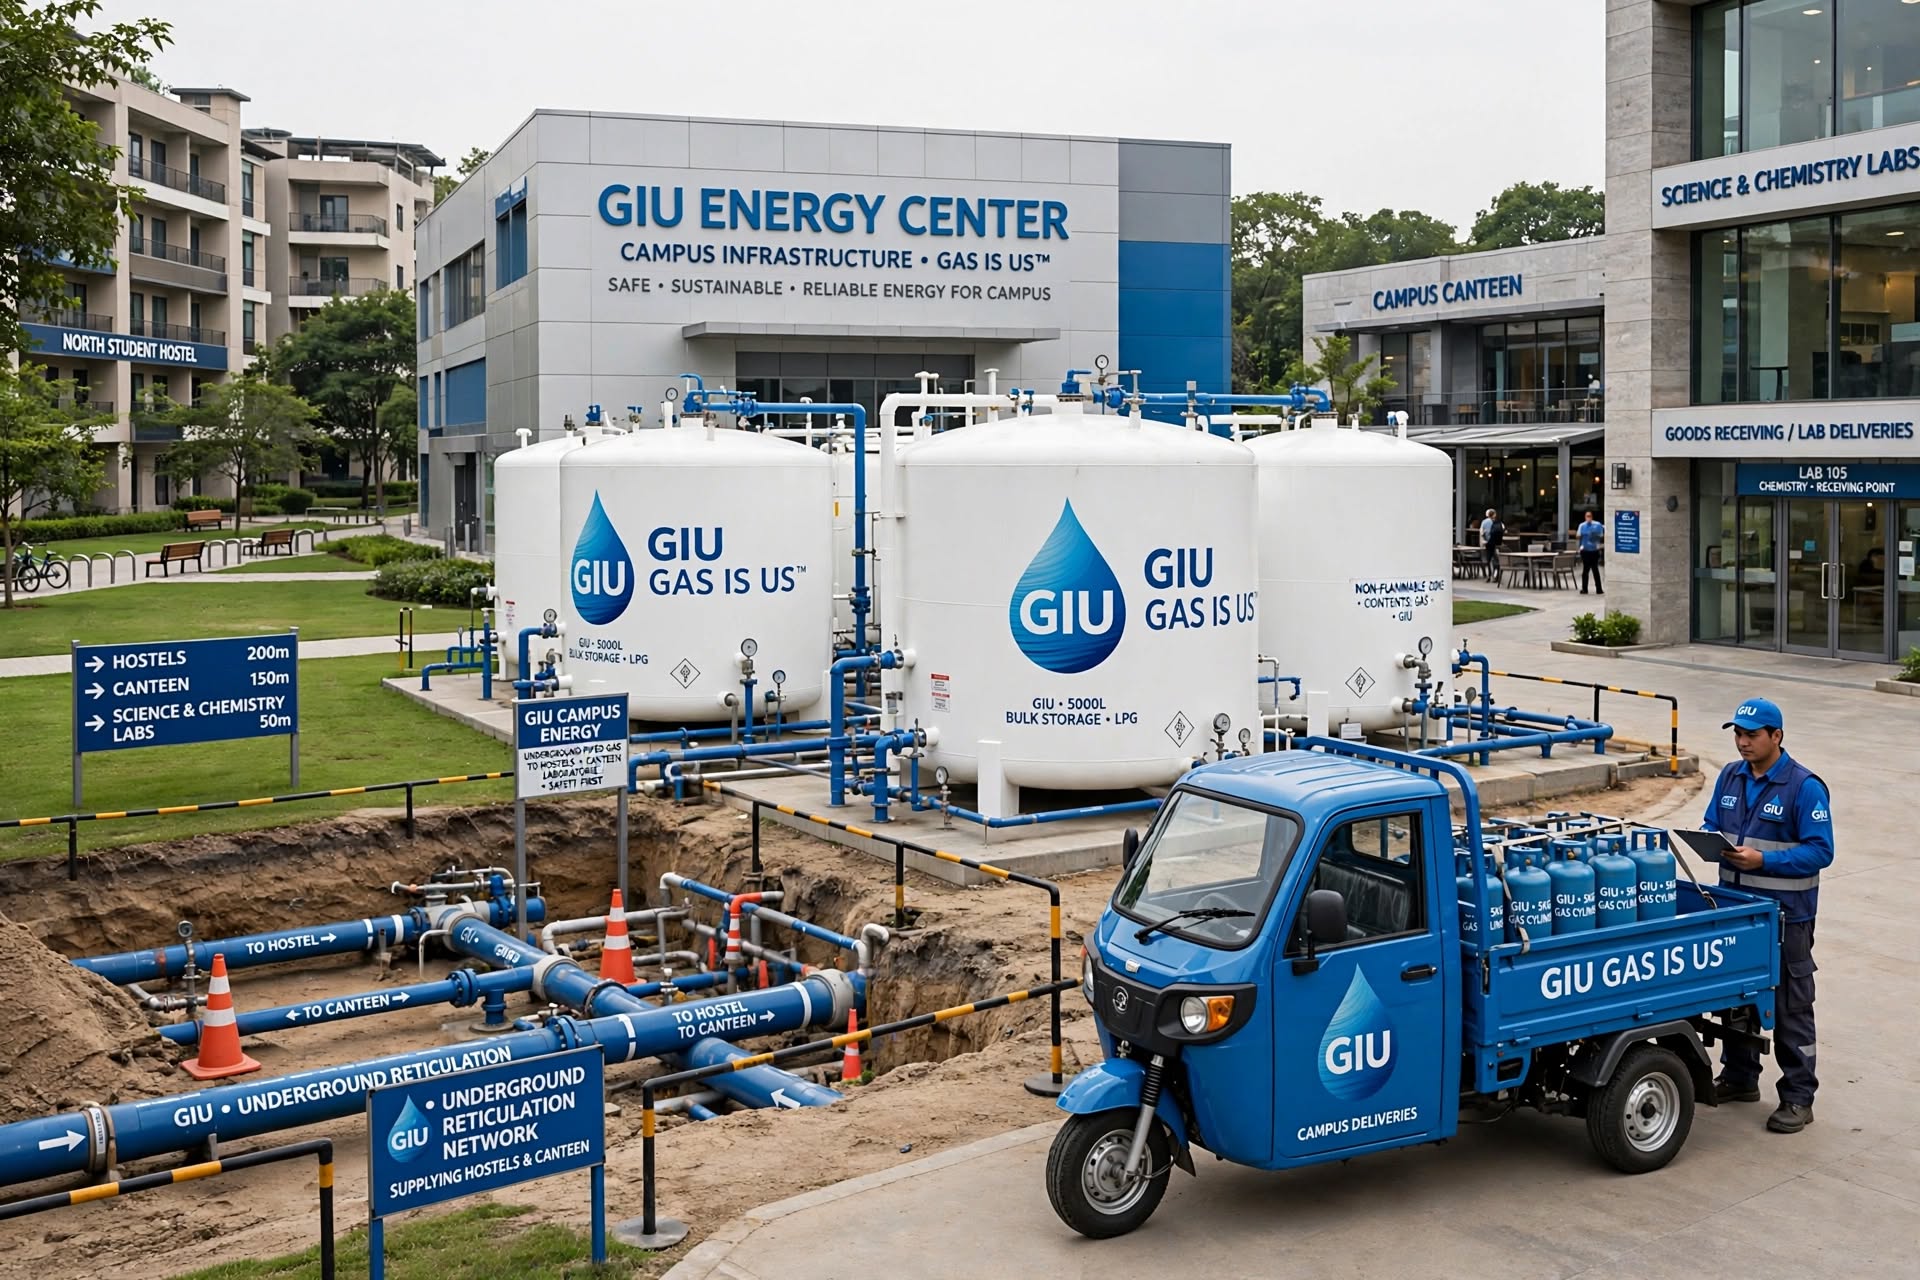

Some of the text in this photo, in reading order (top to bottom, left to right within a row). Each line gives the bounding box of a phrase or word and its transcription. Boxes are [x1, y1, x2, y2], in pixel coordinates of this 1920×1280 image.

[1661, 146, 1920, 207] SCIENCE & CHEMISTRY LABS
[598, 184, 1069, 240] GIU ENERGY CENTER
[620, 242, 715, 263] CAMPUS
[723, 245, 912, 268] INFRASTRUCTURE
[937, 251, 978, 270] GAS
[985, 253, 1002, 271] IS
[608, 277, 1051, 300] SAFE SUSTAINABLE RELIABLE ENERGY FOR CAMPUS
[1373, 274, 1522, 311] CAMPUS CANTEEN
[63, 332, 197, 363] NORTH STUDENT HOSTEL
[1665, 422, 1914, 441] GOODS RECEIVING / LAB DELIVERIES
[1799, 467, 1847, 479] LAB 105
[1759, 481, 1895, 493] CHEMISTRY RECEIVING POINT
[648, 527, 723, 561] GIU
[574, 559, 625, 596] GIU
[1144, 547, 1213, 589] GIU
[649, 568, 713, 595] GAS
[725, 568, 750, 594] IS
[1019, 589, 1114, 635] GIU
[1145, 597, 1205, 630] GAS
[1213, 595, 1230, 626] IS
[1415, 595, 1428, 606] GAS
[1398, 611, 1413, 621] GIU
[597, 639, 623, 650] 5000L
[113, 645, 289, 669] HOSTELS 200m
[585, 651, 621, 663] STORAGE
[630, 654, 648, 664] LPG
[113, 671, 289, 696] CANTEEN 150m
[113, 695, 285, 723] SCIENCE & CHEMISTRY
[525, 704, 621, 726] GIU CAMPUS
[1032, 698, 1106, 710] GIU 5000L
[1737, 705, 1757, 716] GIU
[113, 714, 291, 742] LABS 50m
[1006, 711, 1138, 725] BULK STORAGE LPG
[540, 723, 601, 743] ENERGY
[606, 742, 622, 752] GAS
[527, 761, 538, 771] TO
[1763, 803, 1783, 816] GIU
[1600, 887, 1618, 897] GIU
[1639, 881, 1658, 891] GIU
[1511, 901, 1529, 912] GIU
[1556, 894, 1575, 905] GIU
[1598, 900, 1615, 910] GAS
[1638, 894, 1654, 903] GAS
[1508, 914, 1525, 925] GAS
[1554, 907, 1571, 917] GAS
[246, 934, 319, 955] TO HOSTEL
[1540, 961, 1594, 1000] GIU
[1602, 951, 1656, 988] GAS
[1663, 945, 1685, 977] IS
[302, 993, 390, 1019] TO CANTEEN
[672, 1000, 748, 1024] TO HOSTEL
[678, 1012, 756, 1039] TO CANTEEN
[1325, 1029, 1391, 1075] GIU
[174, 1045, 512, 1127] GIU UNDERGROUND RETICULATION
[442, 1066, 585, 1110] UNDERGROUND
[443, 1091, 575, 1136] RETICULATION
[1297, 1106, 1418, 1141] CAMPUS DELIVERIES
[391, 1127, 428, 1151] GIU
[443, 1122, 539, 1160] NETWORK
[390, 1139, 590, 1198] SUPPLYING HOSTELS & CANTEEN
